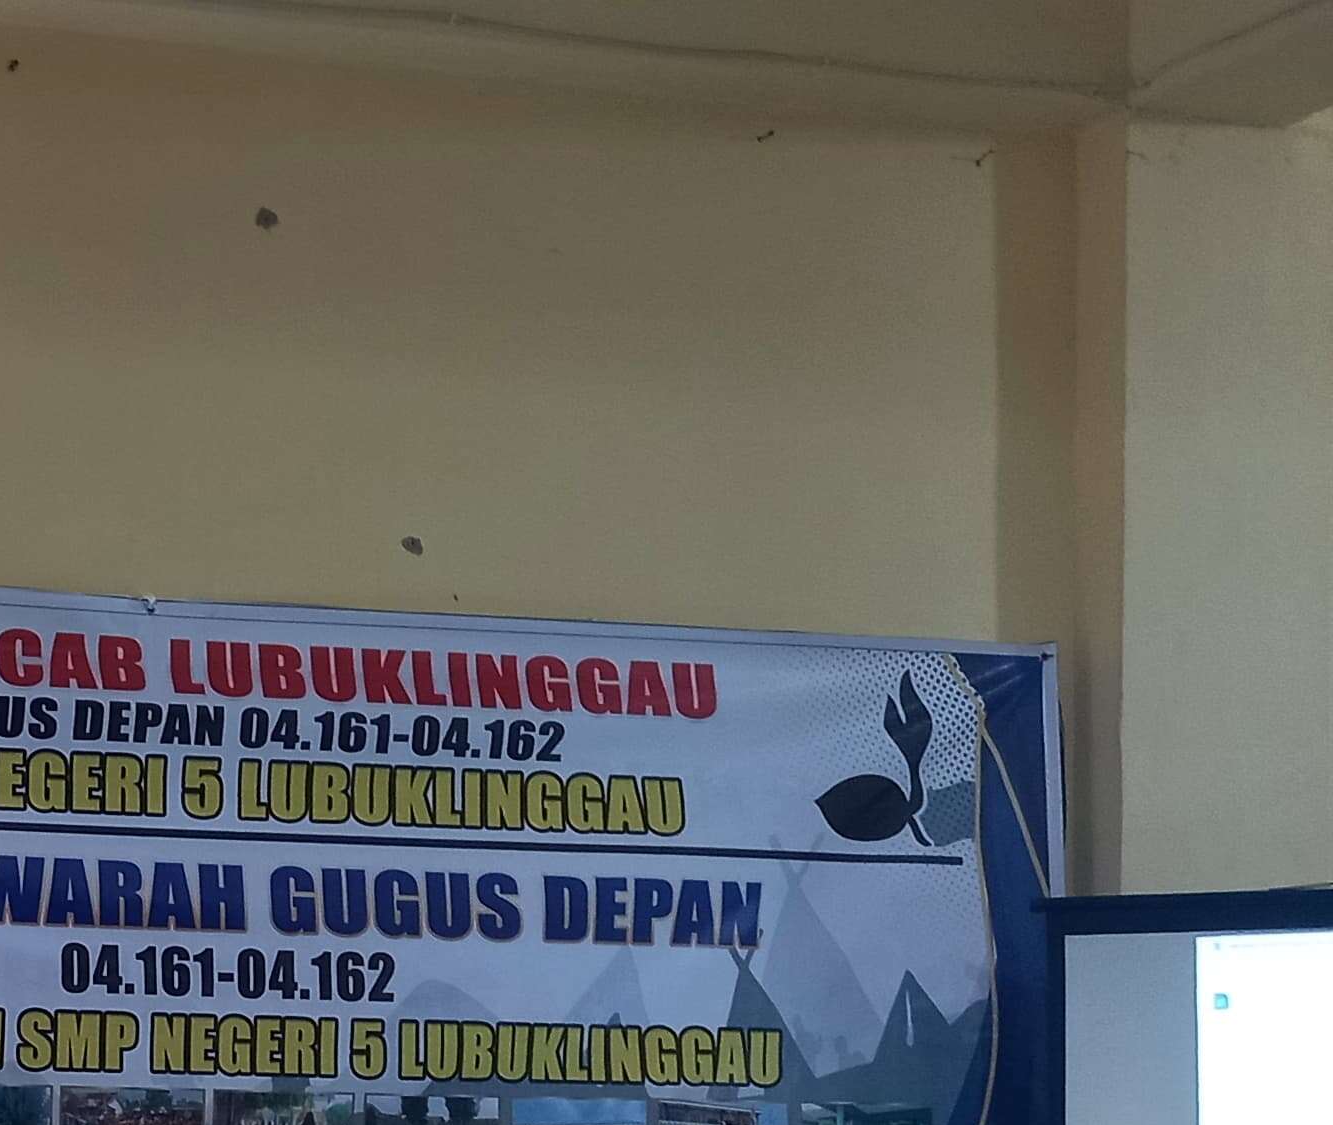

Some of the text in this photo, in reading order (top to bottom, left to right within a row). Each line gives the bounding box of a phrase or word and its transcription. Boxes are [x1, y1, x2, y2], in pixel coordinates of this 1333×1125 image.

[169, 638, 718, 720] LUBUKLINGGAU
[73, 699, 225, 747] DEPAN
[239, 707, 566, 763] 04.161-04.162
[181, 754, 223, 821] 5
[237, 758, 686, 837] LUBUKLINGGAU
[270, 865, 523, 942] GUGUS
[542, 875, 763, 949] DEPAN
[60, 942, 396, 1003] 04.161-04.162
[16, 1006, 140, 1074] SMP
[150, 1012, 339, 1079] NEGERI
[348, 1016, 388, 1081] 5
[398, 1018, 784, 1087] LUBUKLINGGAU
